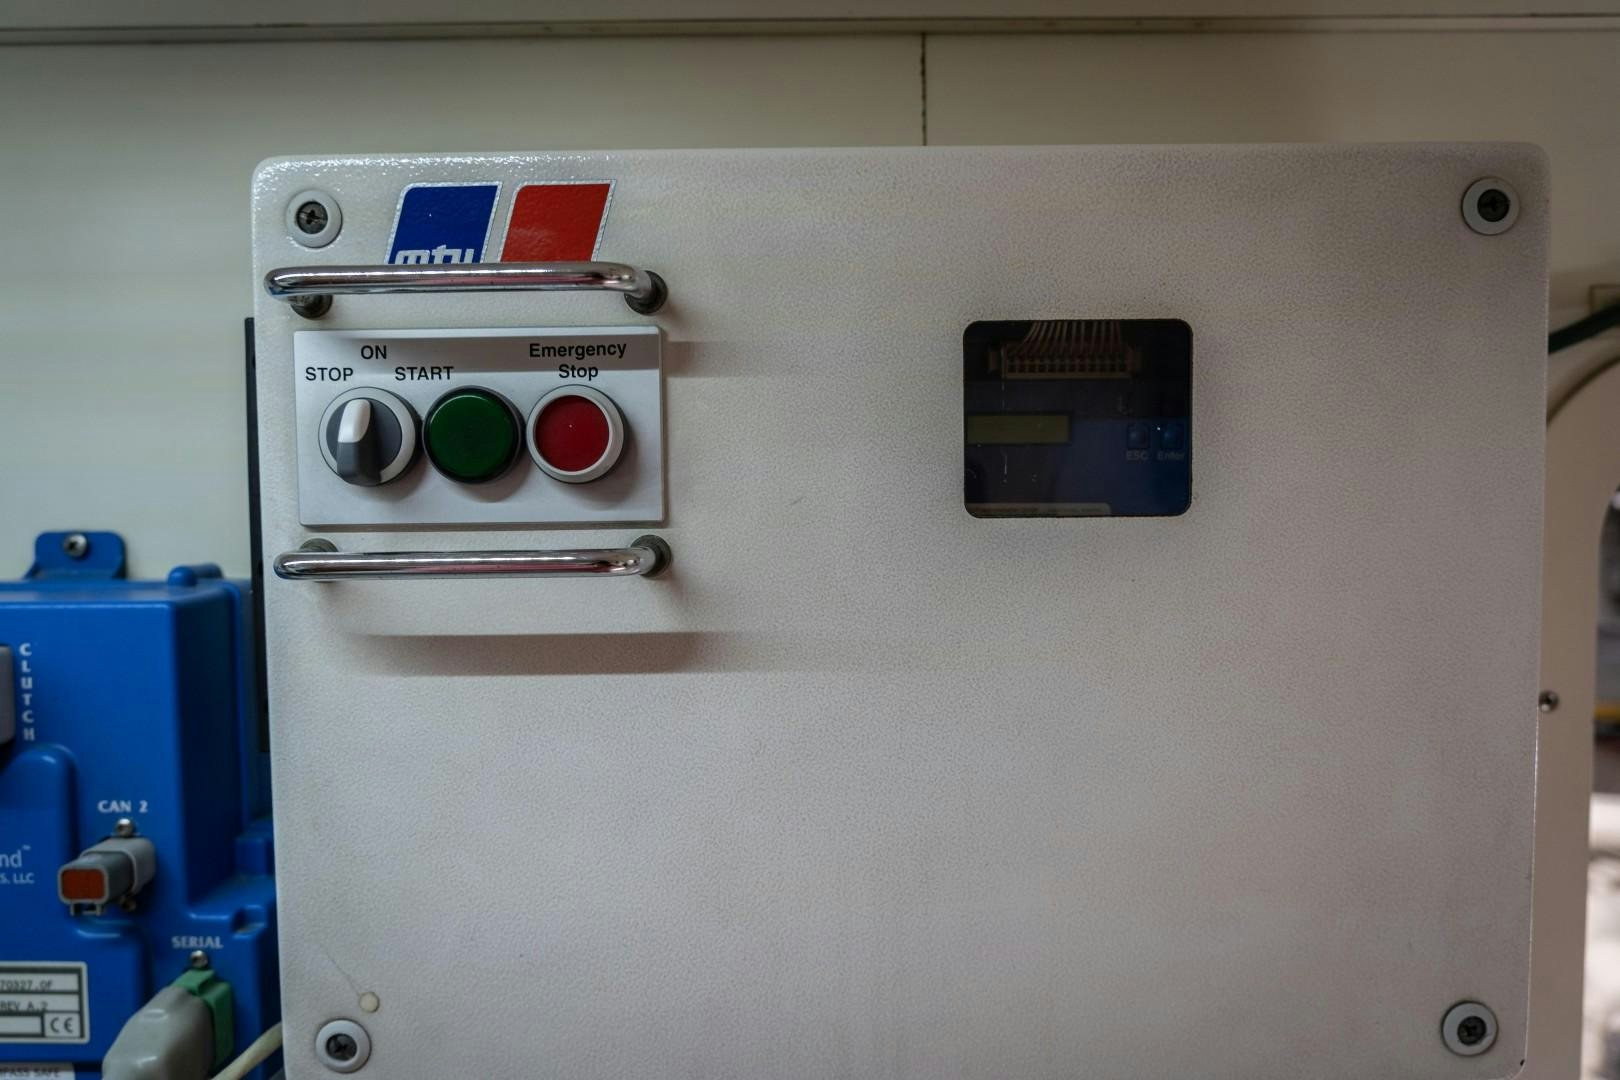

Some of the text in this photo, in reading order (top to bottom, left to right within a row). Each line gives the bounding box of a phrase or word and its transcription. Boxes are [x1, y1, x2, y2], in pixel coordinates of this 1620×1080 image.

[361, 345, 387, 360] ON
[529, 343, 627, 360] Emergency
[305, 367, 354, 382] STOP
[395, 366, 455, 381] START
[558, 364, 599, 381] Stop
[1126, 450, 1149, 461] ESC
[19, 643, 35, 741] CLUTCH
[98, 800, 149, 813] CAN 2
[13, 873, 35, 884] LLC
[171, 936, 224, 949] SERIAL
